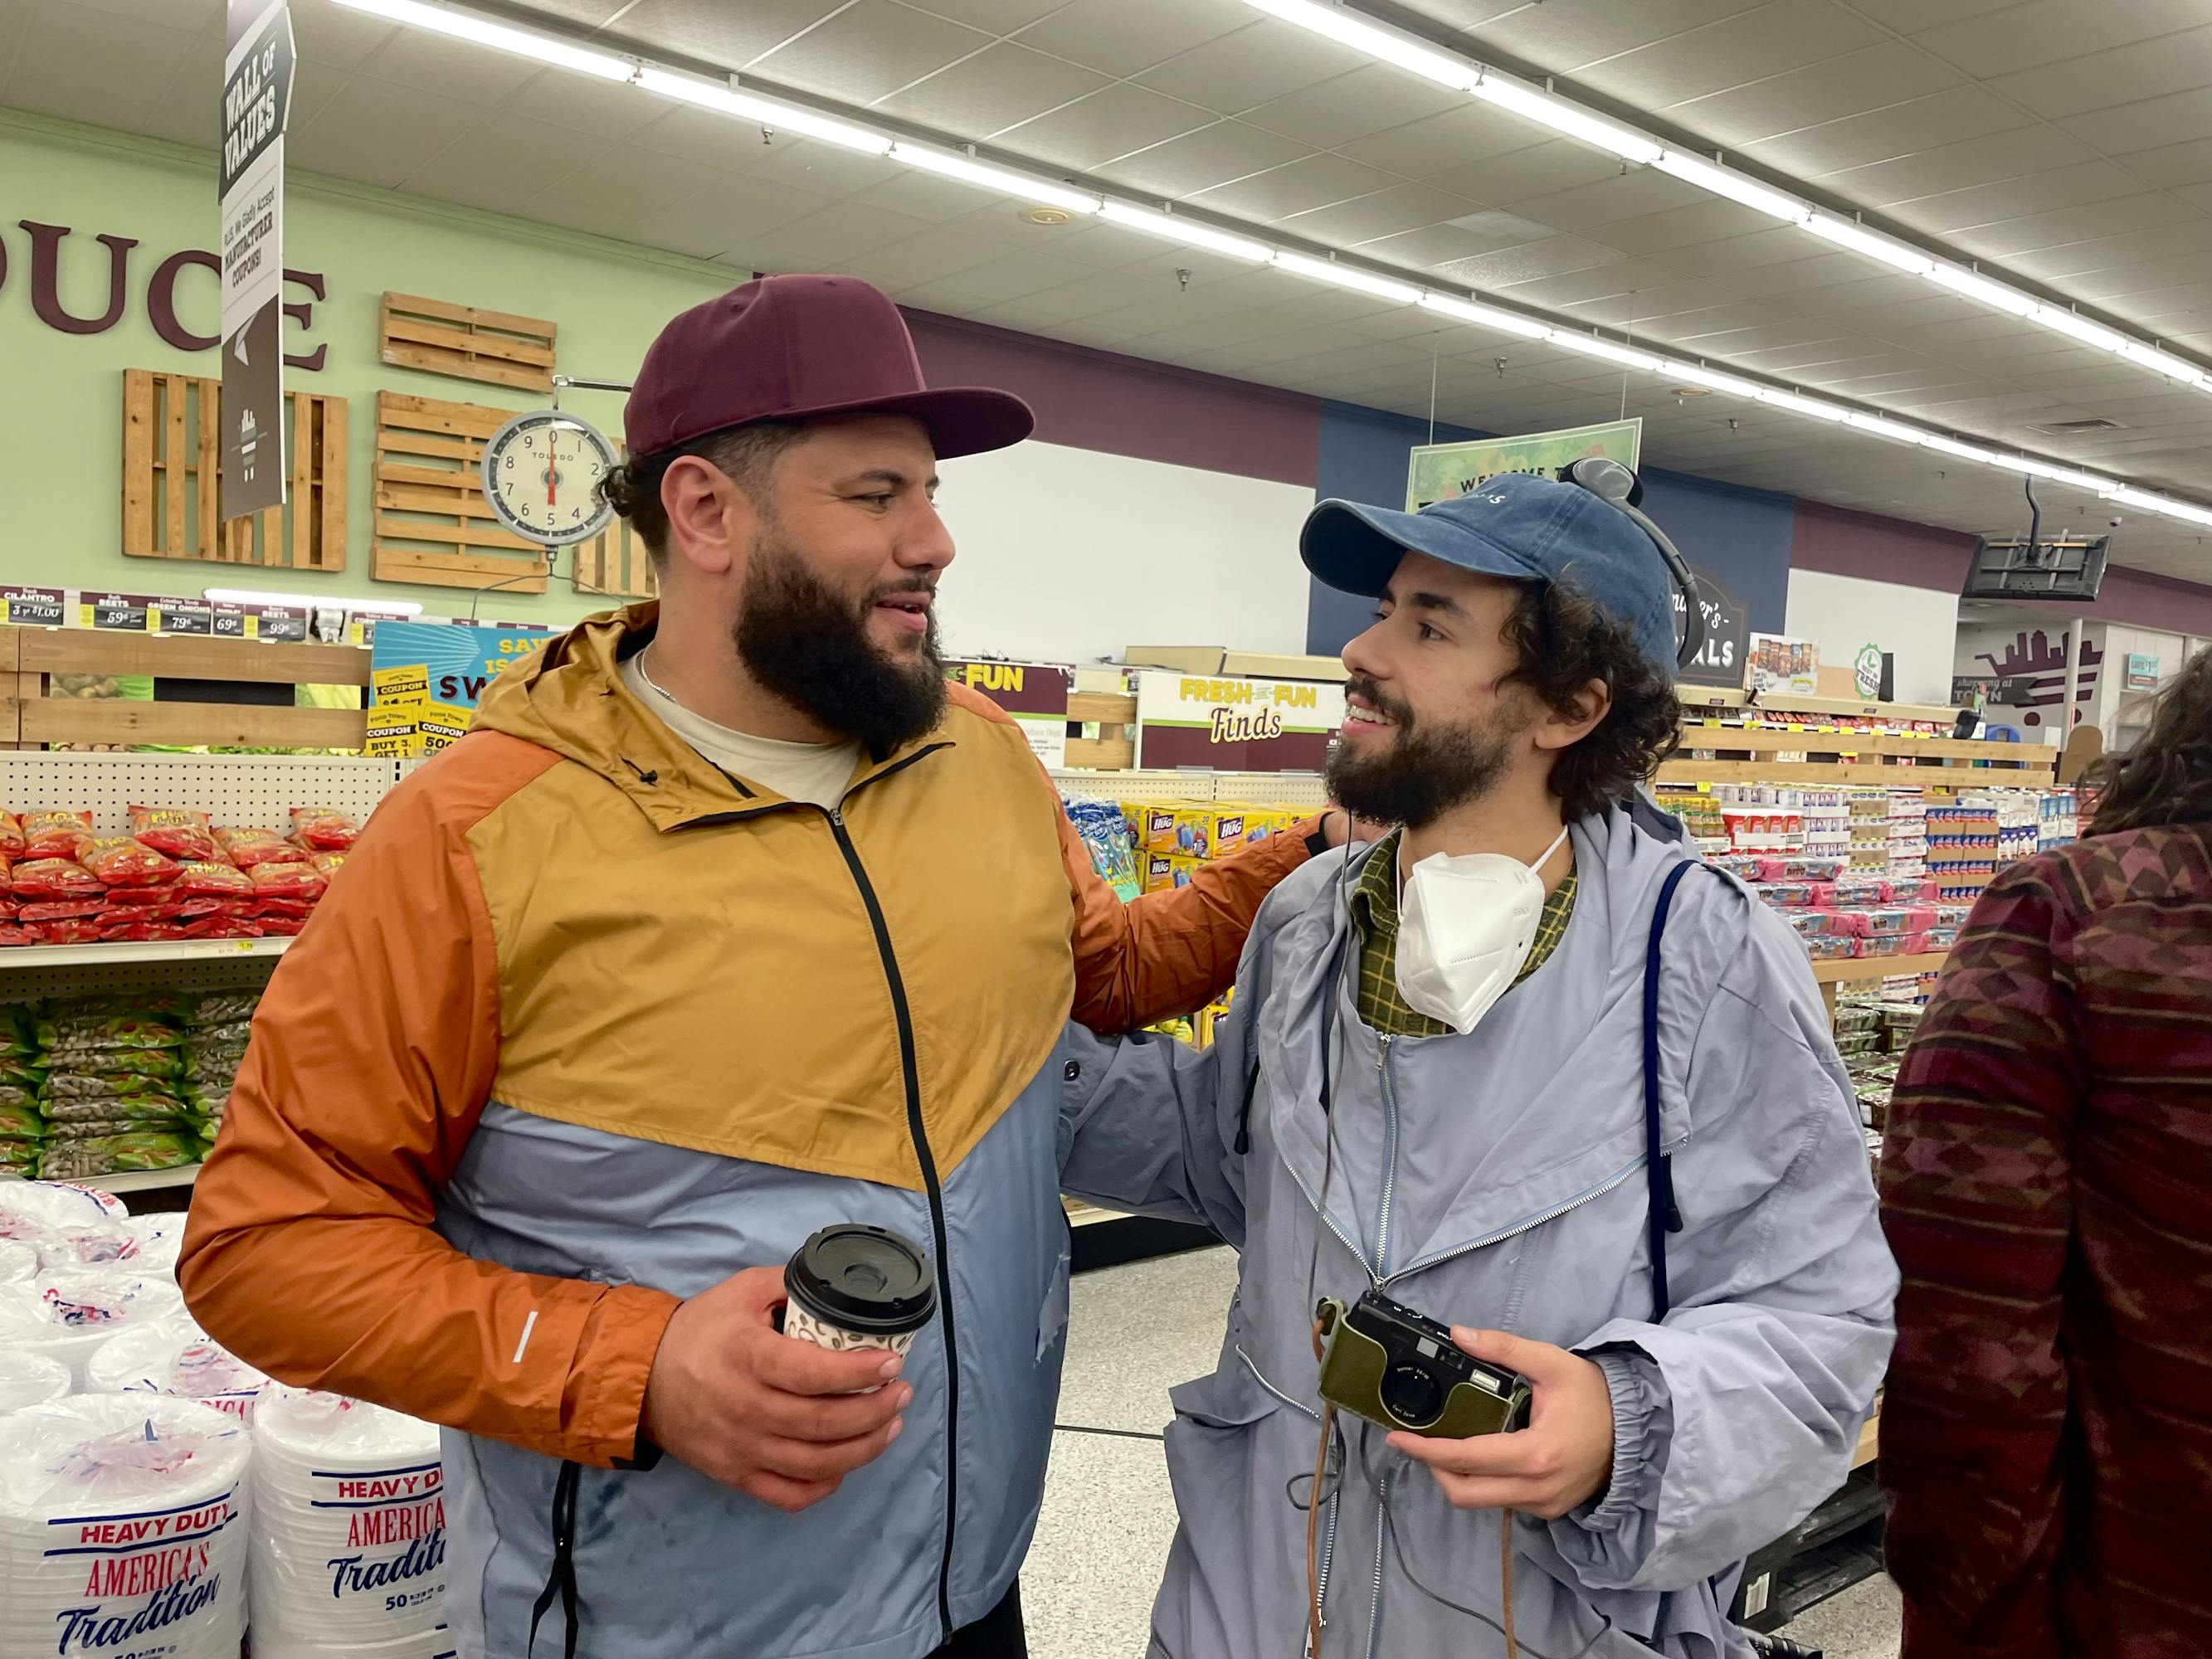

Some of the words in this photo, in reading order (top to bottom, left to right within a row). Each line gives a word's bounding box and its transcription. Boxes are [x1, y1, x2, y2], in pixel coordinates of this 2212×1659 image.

[226, 54, 261, 134] WALL
[262, 41, 276, 77] OF
[225, 85, 275, 180] VALUES
[225, 211, 273, 273] MANUFACTURER
[0, 219, 327, 372] UCE
[524, 435, 533, 449] 9
[548, 431, 558, 443] 0
[577, 440, 581, 453] 1
[506, 456, 514, 469] 8
[532, 452, 573, 461] TOLEDO
[591, 463, 599, 475] 2
[505, 483, 514, 496] 7
[521, 503, 529, 516] 6
[572, 507, 581, 519] 4
[548, 513, 555, 525] 5
[4, 591, 55, 603] CILANTRO
[98, 598, 129, 608] BEETS
[12, 605, 21, 615] 3
[32, 605, 59, 618] $1.00
[147, 601, 177, 611] GREEN
[178, 604, 211, 613] ONIONS
[261, 611, 290, 619] BEETS
[966, 664, 1024, 692] FUN
[1856, 669, 1880, 692] FRESH
[2001, 679, 2013, 688] at
[380, 682, 423, 694] COUPON
[1180, 678, 1253, 705] FRESH
[1273, 684, 1318, 709] FUN
[370, 713, 387, 723] FOOD
[387, 713, 407, 721] TOWN
[430, 711, 446, 719] FOOD
[446, 713, 464, 723] TOWN
[1211, 706, 1281, 741] Finds
[367, 726, 412, 738] COUPON
[421, 722, 465, 737] COUPON
[371, 740, 397, 751] BUY
[1153, 817, 1173, 830] HUG
[1220, 821, 1242, 839] HUG
[1152, 863, 1170, 874] HUG
[338, 1476, 419, 1499] HEAVY
[82, 1517, 170, 1545] HEAVY
[174, 1502, 231, 1533] DUTY
[83, 1540, 211, 1598] AMERICA'S
[386, 1594, 407, 1611] 50
[56, 1572, 221, 1656] Tradition
